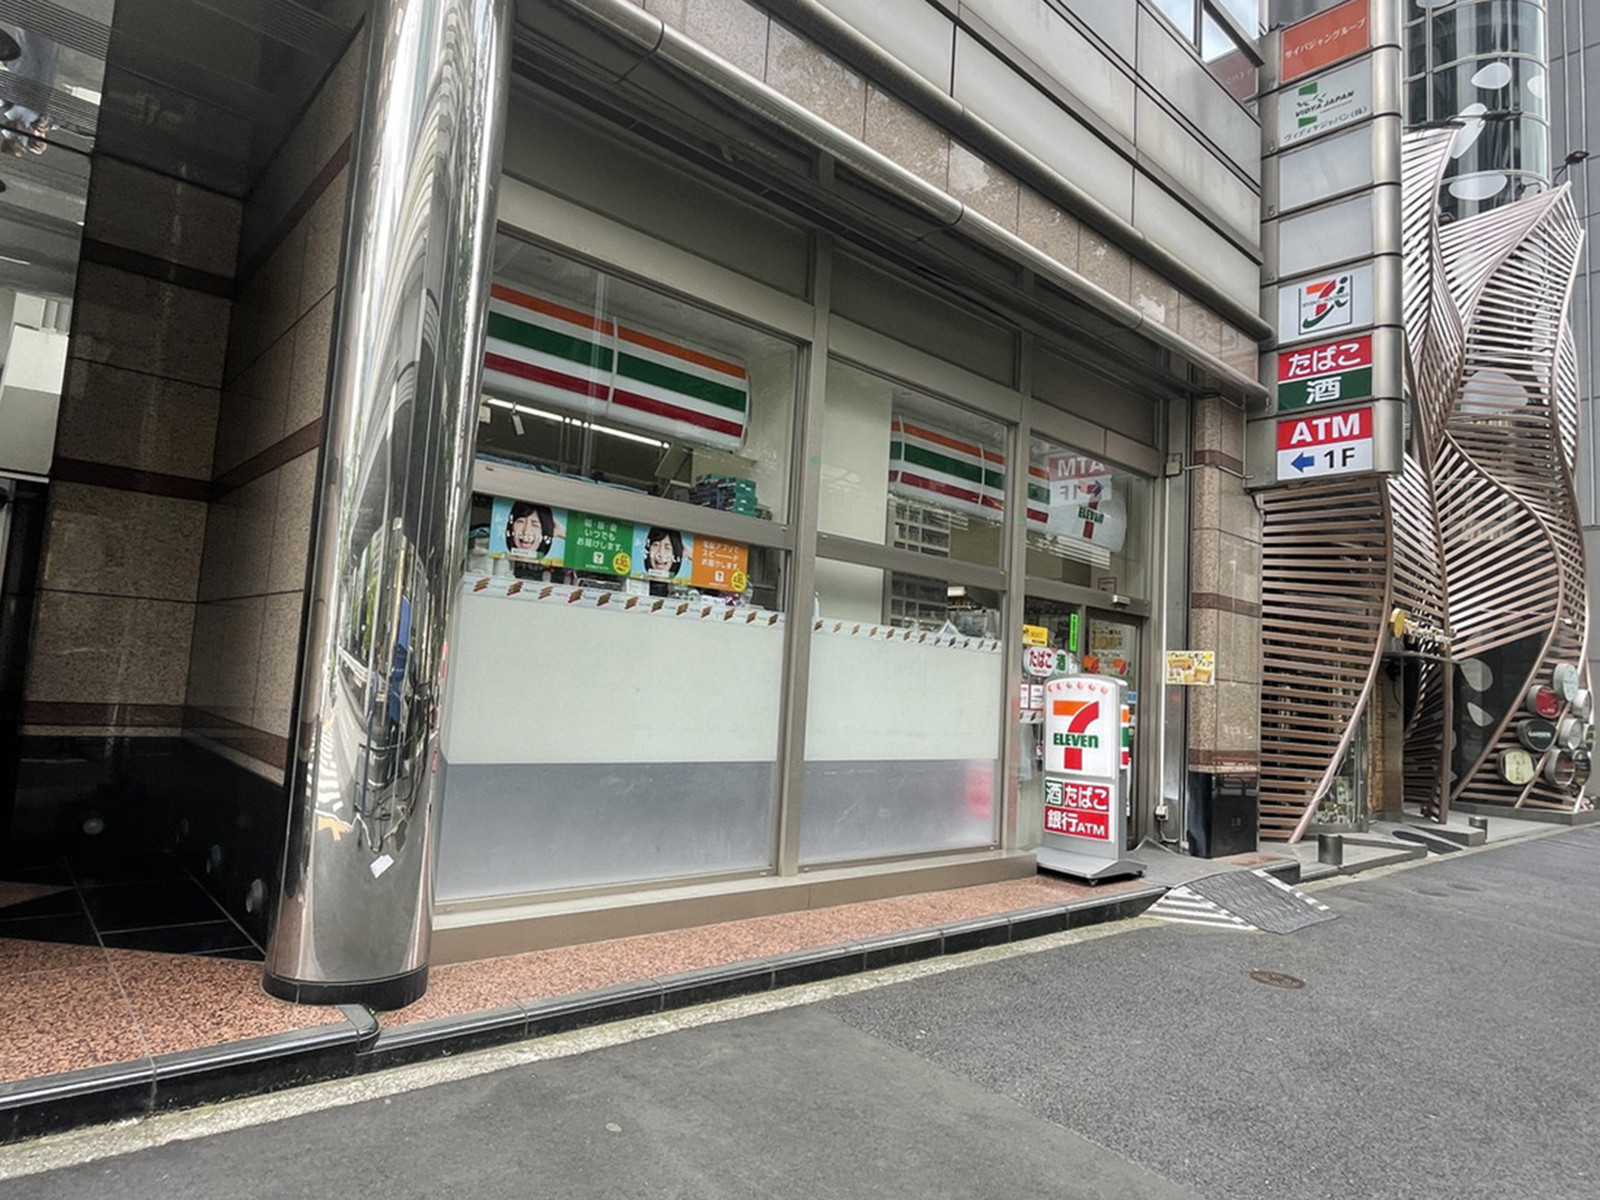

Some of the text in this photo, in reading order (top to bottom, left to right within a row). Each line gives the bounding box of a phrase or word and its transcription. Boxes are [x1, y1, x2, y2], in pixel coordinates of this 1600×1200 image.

[1323, 90, 1355, 107] JAPAN
[1288, 343, 1361, 377] たばこ
[1306, 376, 1342, 405] 酒
[1290, 413, 1360, 445] ATM
[1323, 447, 1355, 469] 1F
[584, 529, 616, 541] いつでも
[1029, 650, 1053, 668] たばこ
[1053, 700, 1099, 770] 7
[1045, 781, 1108, 810] 酒 たばこ
